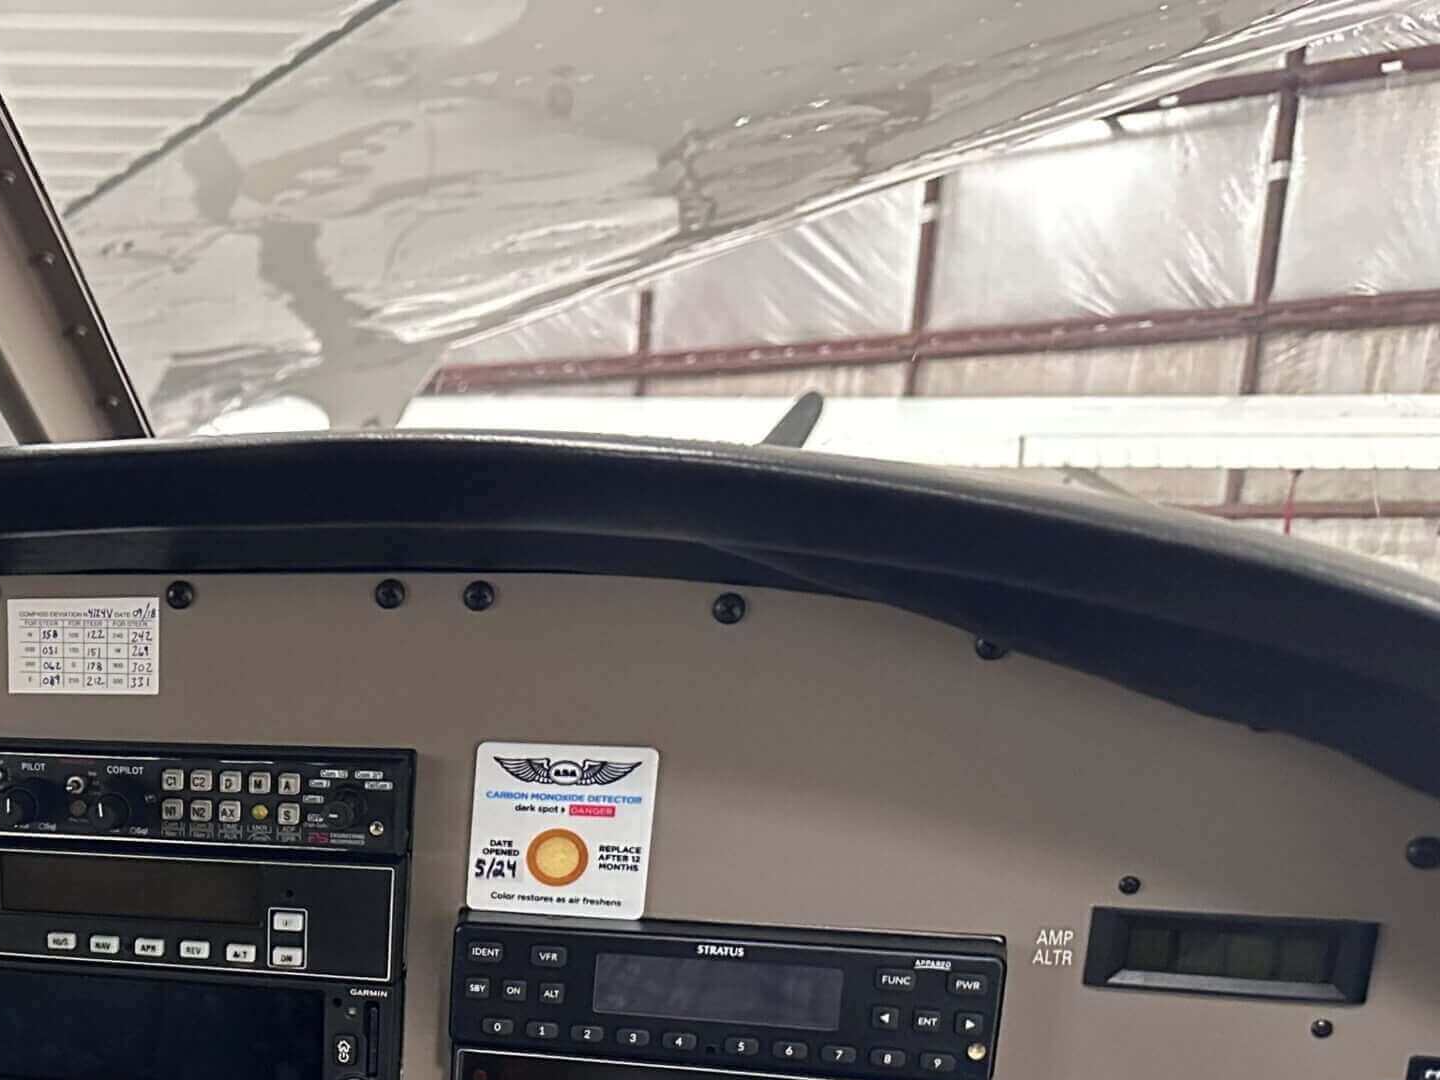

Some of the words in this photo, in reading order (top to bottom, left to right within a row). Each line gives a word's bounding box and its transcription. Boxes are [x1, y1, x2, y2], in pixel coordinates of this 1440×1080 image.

[87, 630, 104, 639] 122
[131, 632, 152, 642] 242
[87, 676, 104, 686] 212
[131, 677, 150, 687] 331
[22, 763, 45, 771] PILOT
[107, 765, 144, 775] COPILOT
[193, 777, 205, 787] C2
[486, 791, 528, 800] CARBON
[531, 793, 583, 802] MONOXIDE
[588, 795, 642, 804] DETECTOR
[192, 807, 205, 817] N2
[538, 805, 558, 814] spot
[571, 807, 613, 815] DANGER
[482, 848, 519, 856] OPENED
[600, 846, 641, 854] REPLACE
[599, 854, 628, 863] AFTER
[632, 855, 640, 863] 12
[475, 858, 517, 880] 5/24
[599, 863, 639, 872] MONTHS
[518, 893, 553, 903] restores
[568, 896, 579, 904] air
[583, 897, 621, 907] freshens
[1036, 929, 1073, 945] AMP
[472, 948, 499, 957] IDENT
[539, 953, 557, 962] VFR
[697, 945, 744, 957] STRATUS
[1032, 950, 1072, 966] ALTR
[882, 976, 910, 985] FUNC
[956, 980, 980, 990] PWR
[350, 987, 387, 998] GARMIN
[470, 984, 485, 992] SBY
[544, 990, 559, 998] ALT
[918, 1017, 937, 1026] ENT
